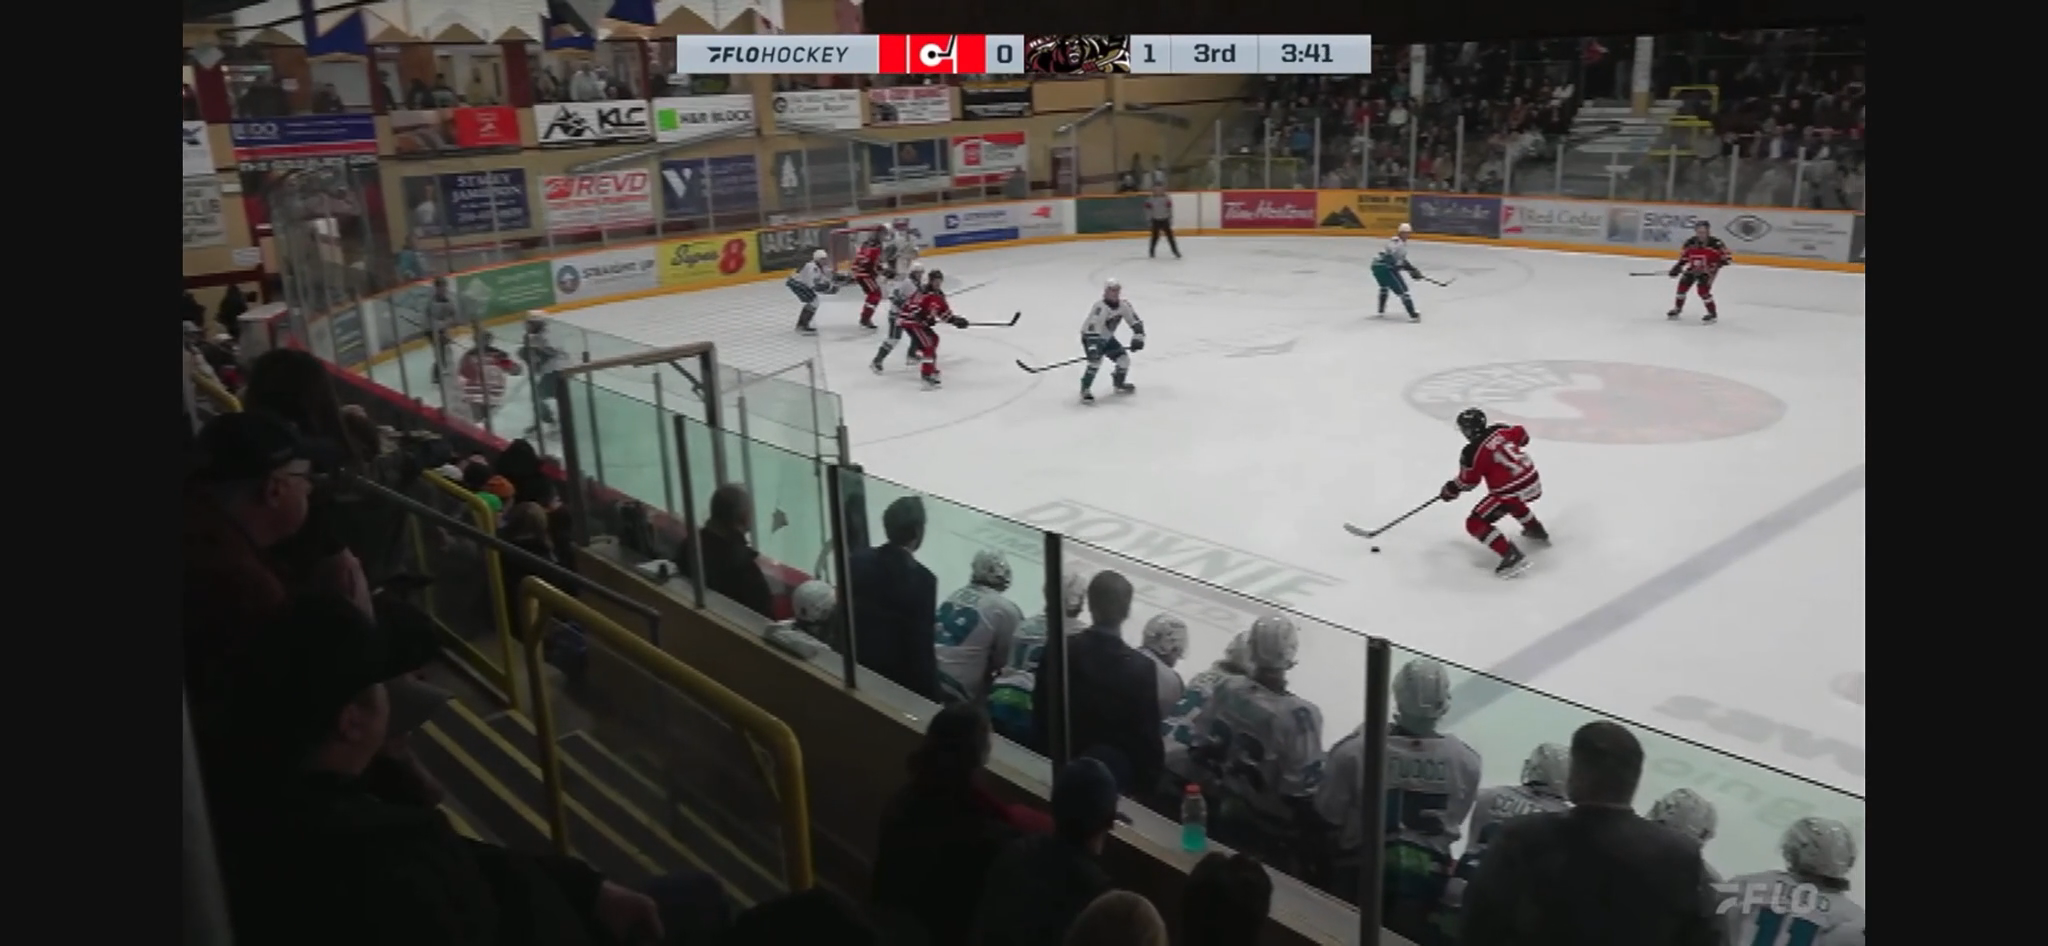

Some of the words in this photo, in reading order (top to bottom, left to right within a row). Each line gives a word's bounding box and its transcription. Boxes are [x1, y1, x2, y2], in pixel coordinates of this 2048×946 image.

[598, 107, 647, 129] KLC
[712, 109, 752, 122] BLOCK
[1224, 201, 1253, 219] Tim
[1254, 199, 1314, 219] Hortons
[1526, 207, 1553, 224] Red
[1557, 209, 1603, 227] Cedar
[1643, 212, 1697, 229] SIGNS
[670, 243, 719, 268] Super
[718, 238, 746, 275] 8
